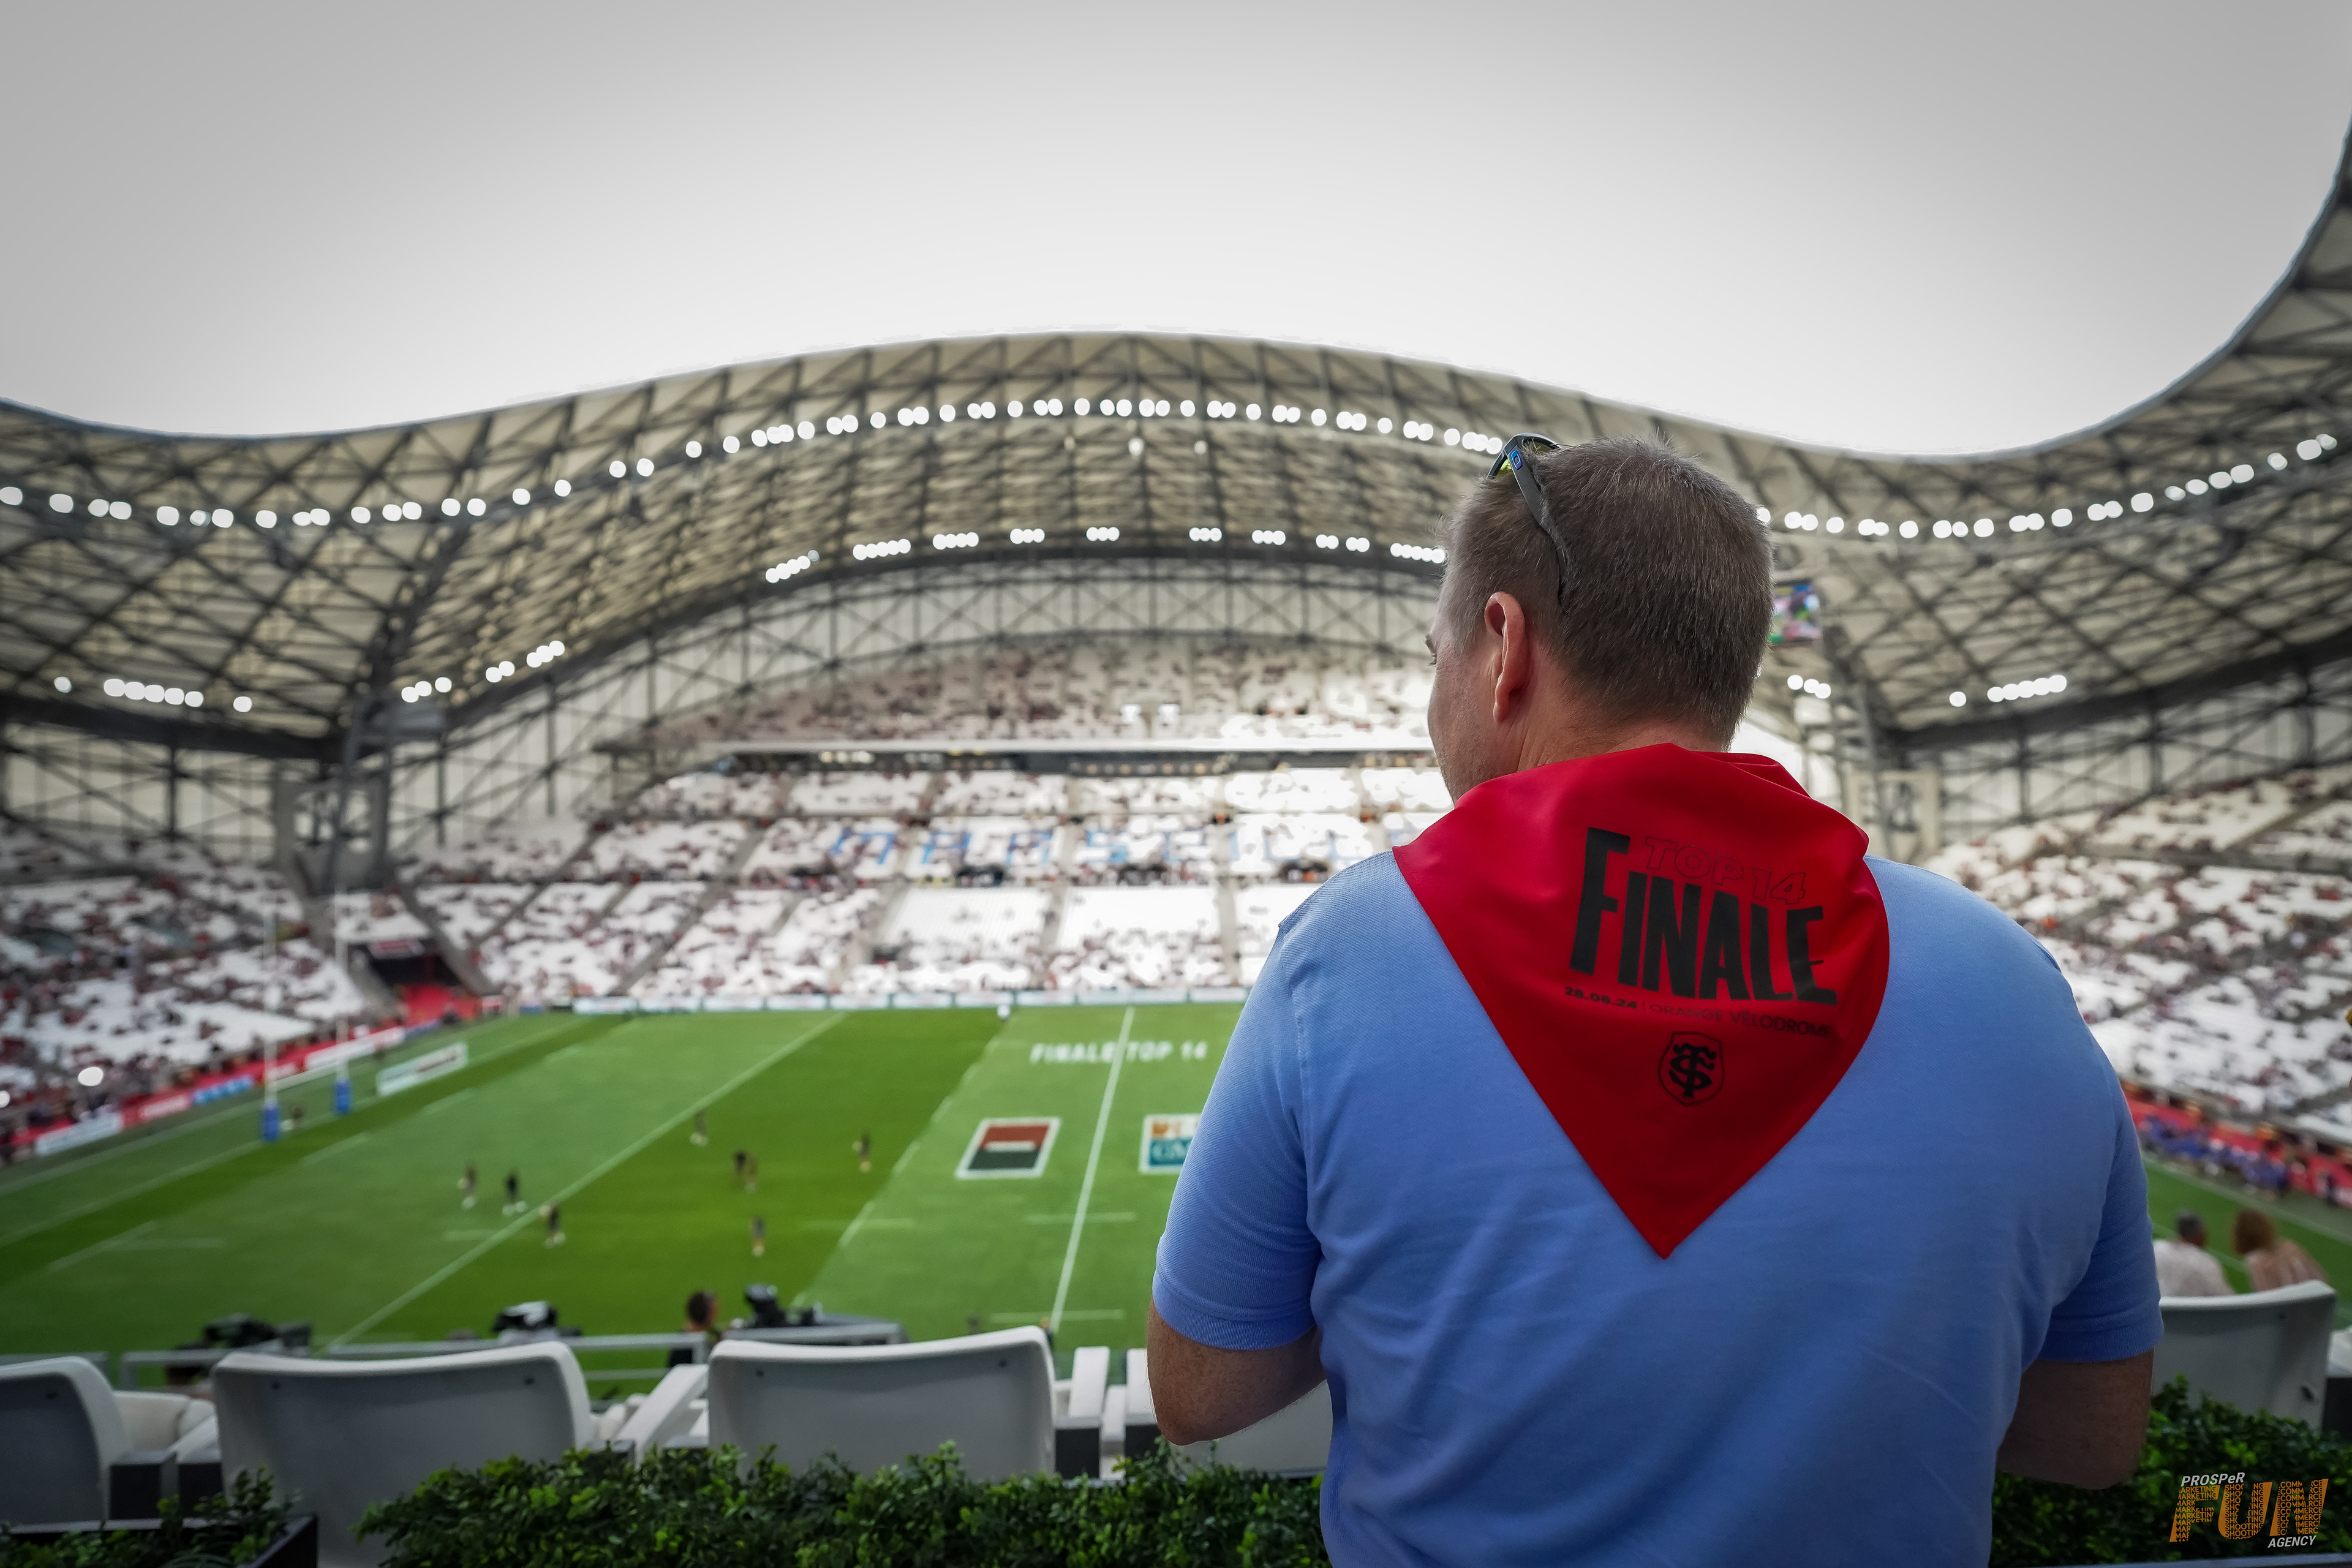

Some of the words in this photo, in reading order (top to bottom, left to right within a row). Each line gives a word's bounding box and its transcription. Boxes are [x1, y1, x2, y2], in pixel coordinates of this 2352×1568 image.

[1645, 836, 1744, 886] TOP
[1751, 867, 1807, 905] 14
[1569, 826, 1838, 1006] FINALE
[1564, 986, 1637, 1009] 28.06.24
[1650, 1004, 1723, 1022] ORANGE
[1730, 1009, 1833, 1038] VÉLODROME
[1028, 1042, 1118, 1065] FINALE
[1125, 1040, 1174, 1062] TOP
[1180, 1040, 1208, 1061] 14
